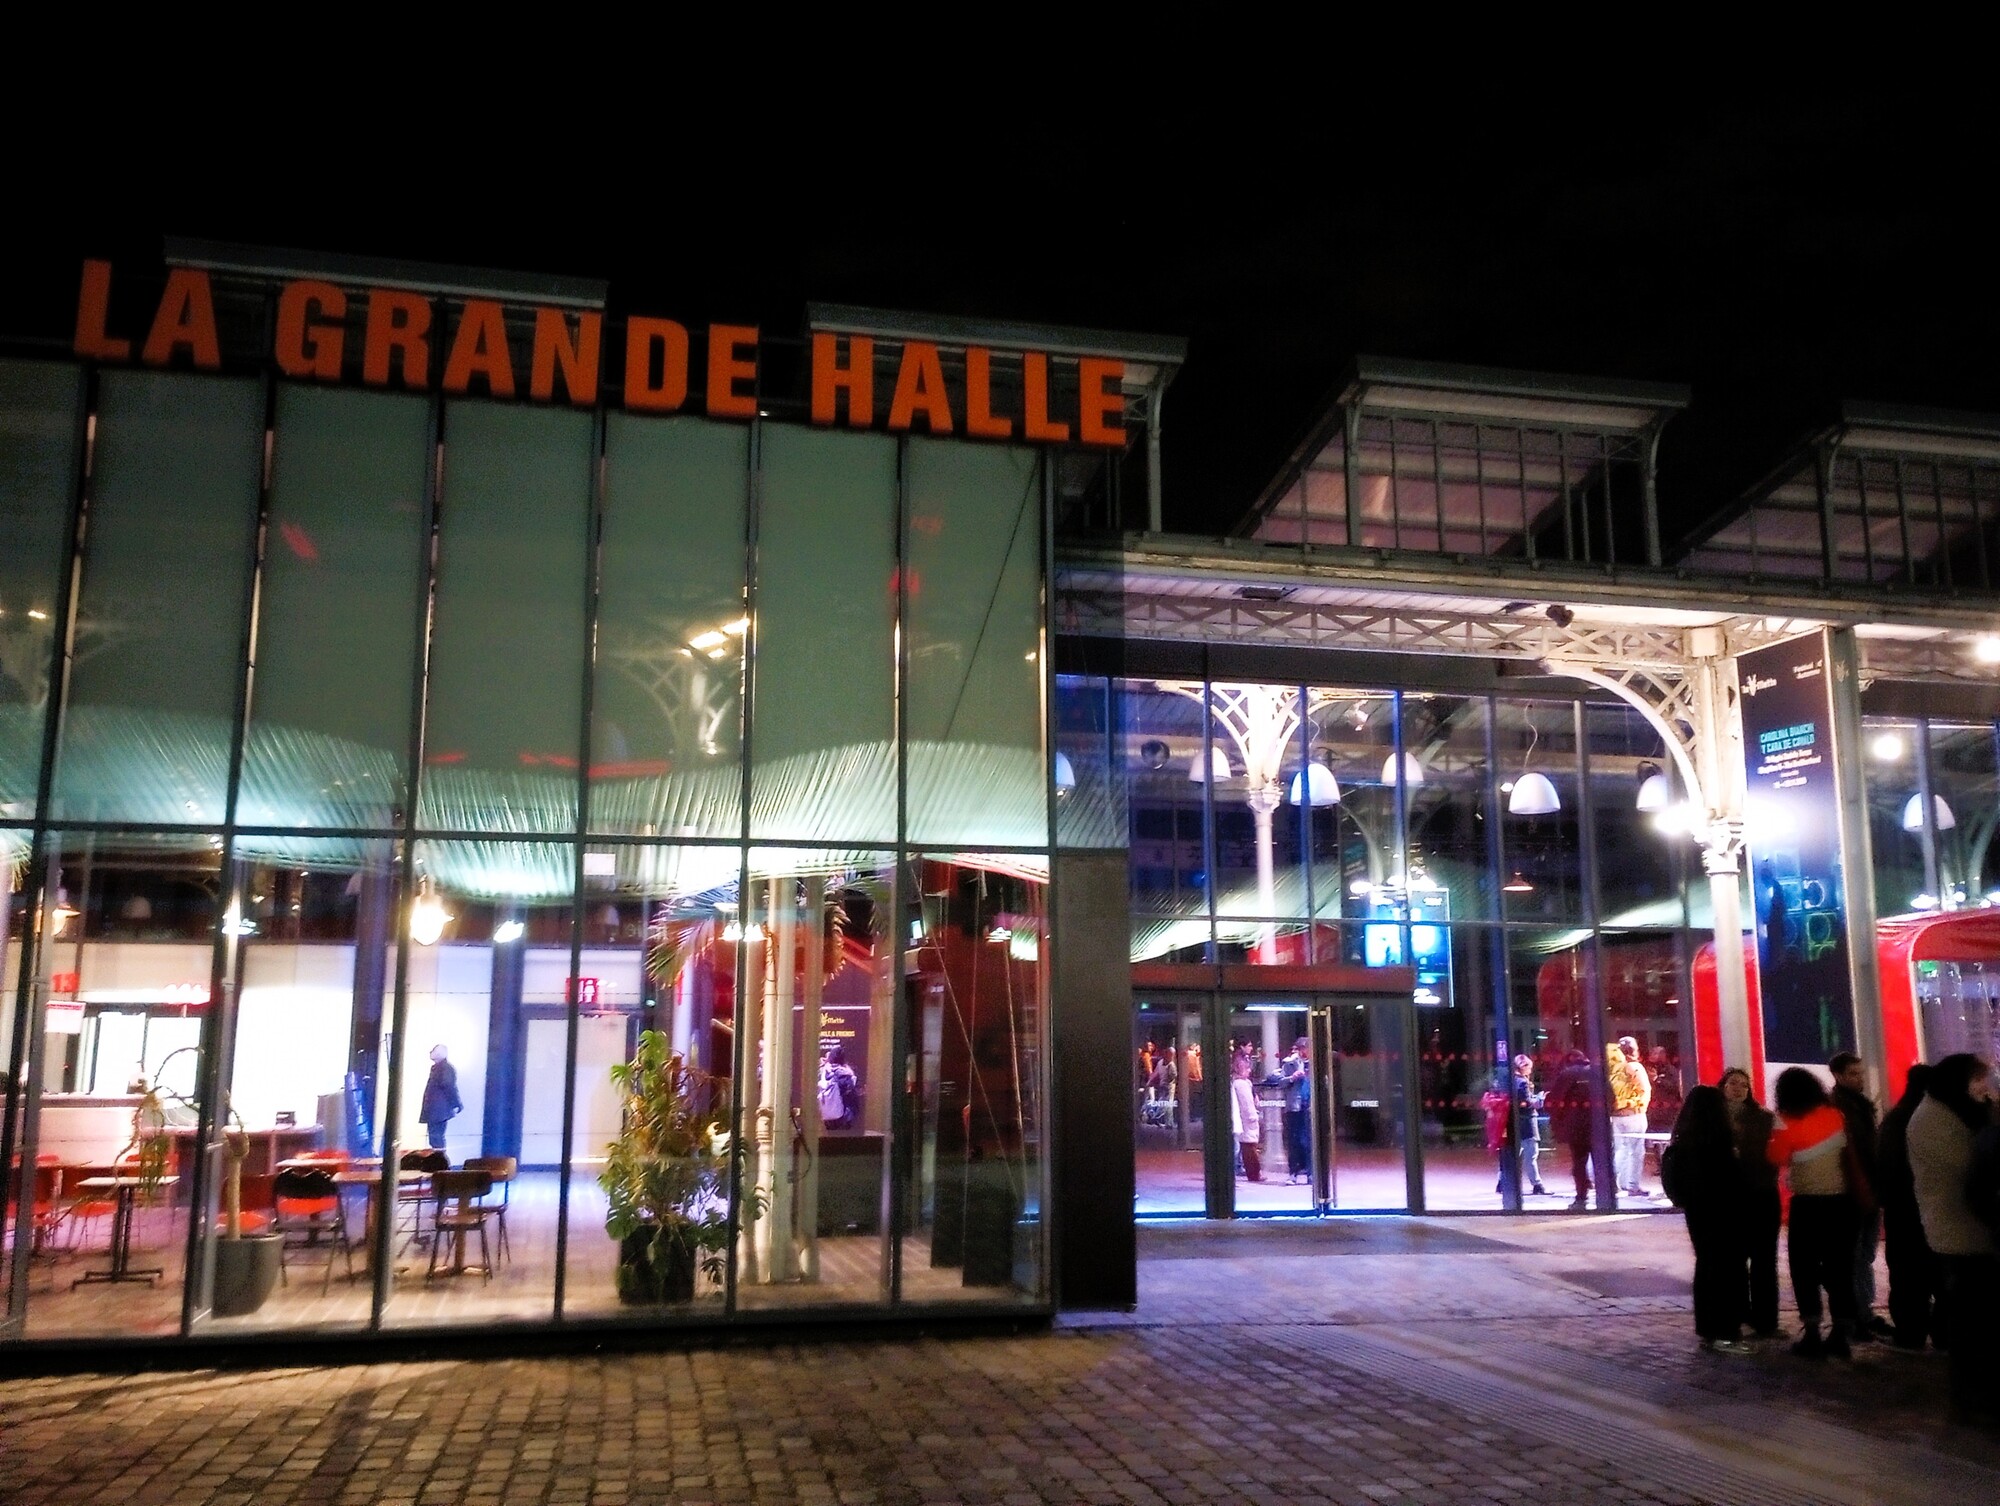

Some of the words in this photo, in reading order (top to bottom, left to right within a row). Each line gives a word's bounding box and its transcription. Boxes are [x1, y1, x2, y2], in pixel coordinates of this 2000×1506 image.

[74, 259, 220, 368] LA
[274, 280, 758, 417] GRANDE
[811, 333, 1126, 445] HALLE
